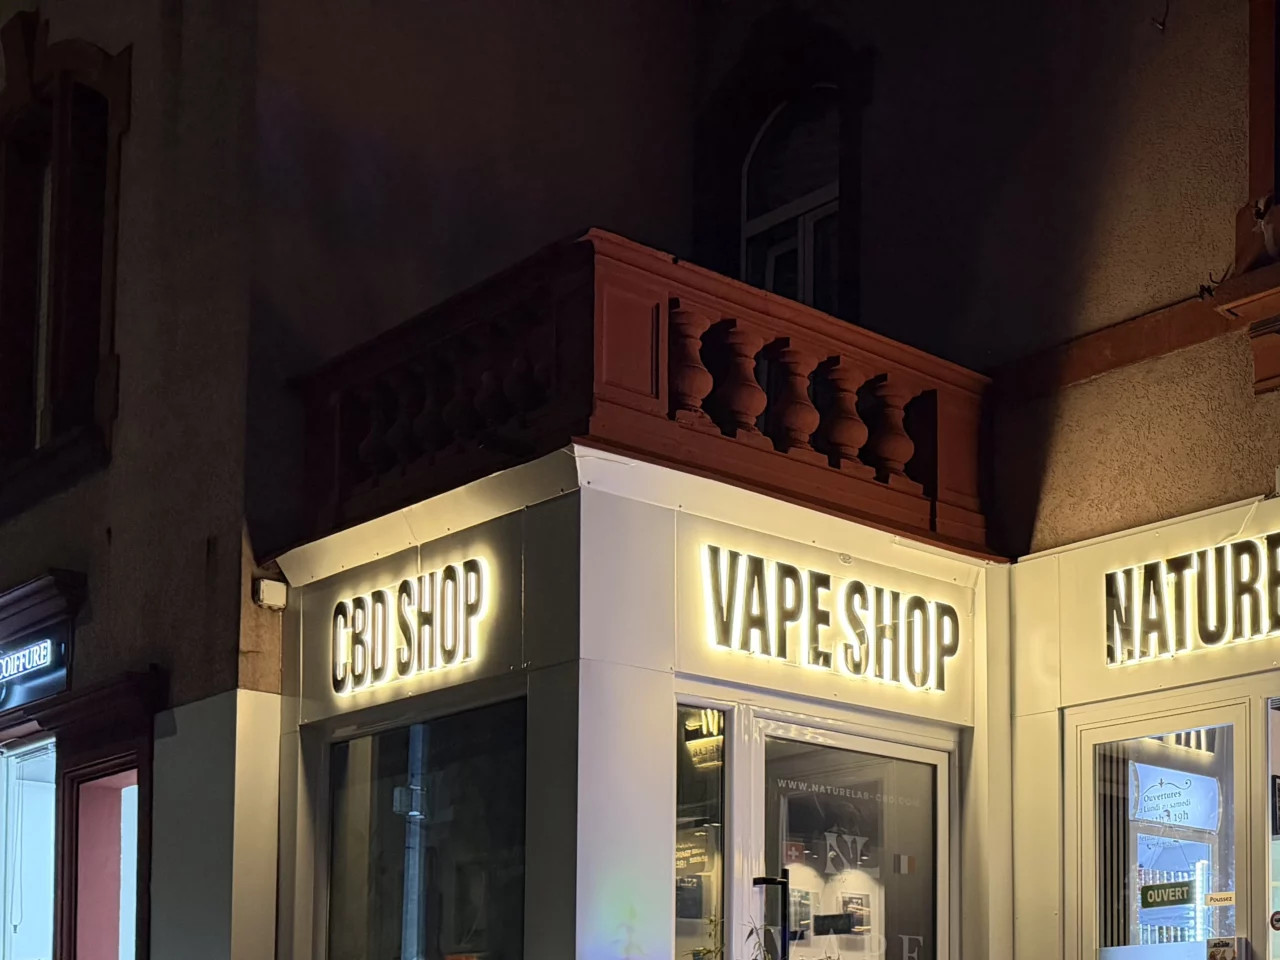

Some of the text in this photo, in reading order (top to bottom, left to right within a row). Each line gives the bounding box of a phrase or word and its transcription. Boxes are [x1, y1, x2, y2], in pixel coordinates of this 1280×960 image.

[705, 544, 960, 692] VAPE SHOP
[332, 558, 484, 694] CBD SHOP
[1143, 791, 1182, 802] Ouvertures
[1170, 799, 1191, 808] samedi
[1174, 810, 1189, 823] 19h
[1147, 886, 1189, 903] OUVERT
[1209, 895, 1233, 904] Poussez
